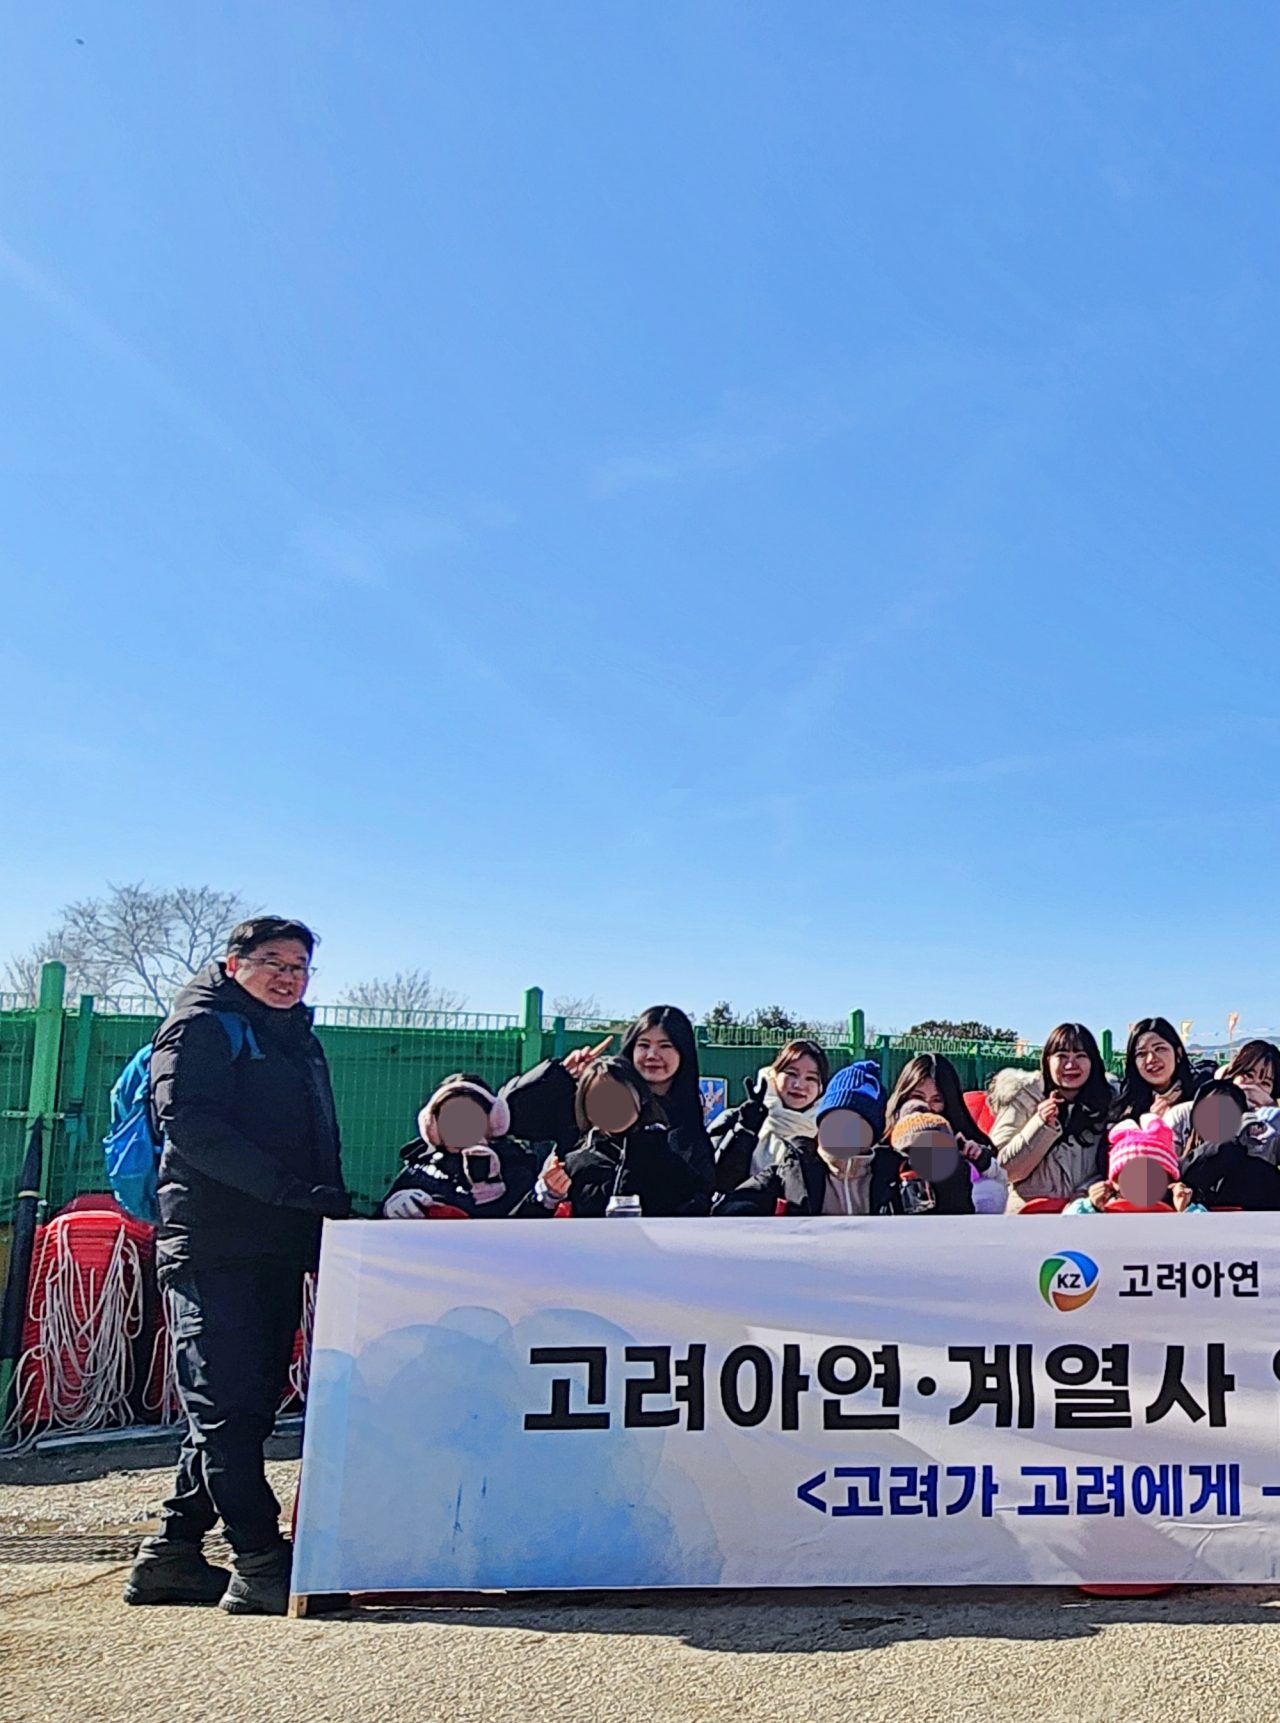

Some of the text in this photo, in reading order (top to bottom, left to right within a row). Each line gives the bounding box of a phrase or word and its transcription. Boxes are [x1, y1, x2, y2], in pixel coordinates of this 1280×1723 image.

[1055, 1271, 1082, 1289] KZ
[1119, 1261, 1260, 1299] 고려아연
[523, 1344, 1235, 1431] 고려아연·계열사
[797, 1465, 999, 1518] <고려가
[1018, 1464, 1241, 1518] 고려에게
